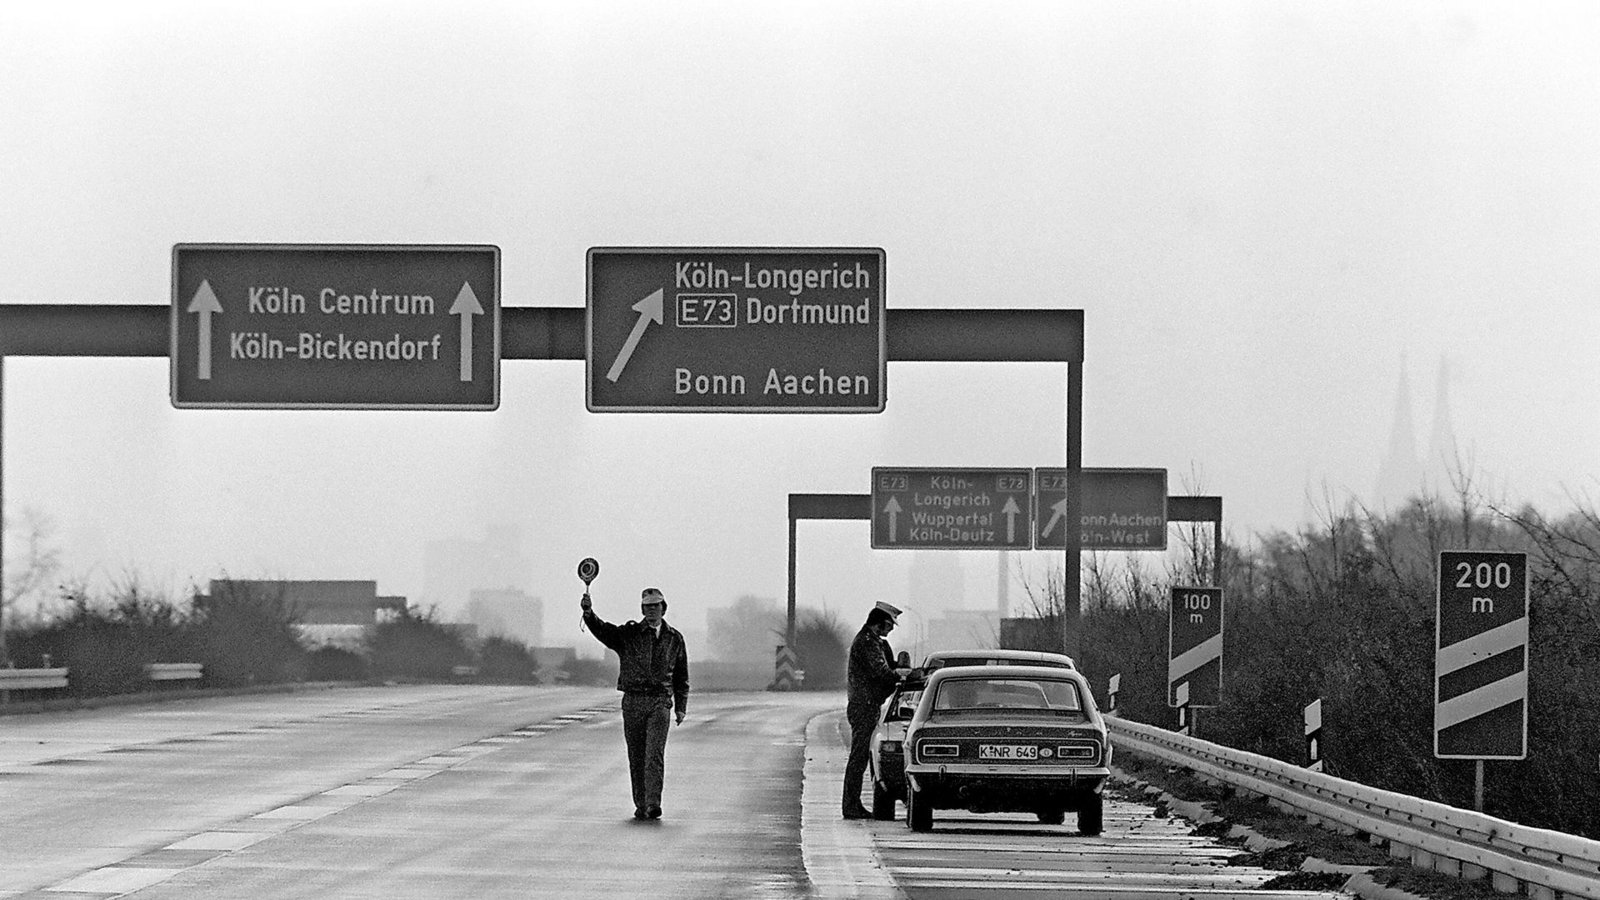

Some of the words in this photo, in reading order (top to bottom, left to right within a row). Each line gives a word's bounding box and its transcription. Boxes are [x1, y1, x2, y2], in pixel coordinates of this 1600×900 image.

[676, 262, 870, 295] Köln-Longerich
[249, 287, 306, 314] Köln
[320, 288, 434, 315] Centrum
[747, 298, 869, 324] Dortmund
[230, 332, 441, 360] Köln-Bickendorf
[676, 368, 745, 394] Bonn
[764, 368, 869, 394] Aachen
[931, 476, 973, 489] Köln-
[914, 493, 990, 509] Longerich
[912, 512, 993, 527] Wuppertal
[1081, 516, 1107, 526] onn
[1109, 513, 1162, 526] Aachen
[910, 528, 994, 541] Köln-Deutz
[1081, 530, 1149, 543] öln-West
[1455, 562, 1510, 588] 200
[1184, 595, 1210, 609] 100
[1472, 597, 1493, 612] m
[1190, 613, 1202, 623] m
[980, 747, 988, 757] K
[994, 747, 1010, 757] NR
[1016, 747, 1036, 757] 649
